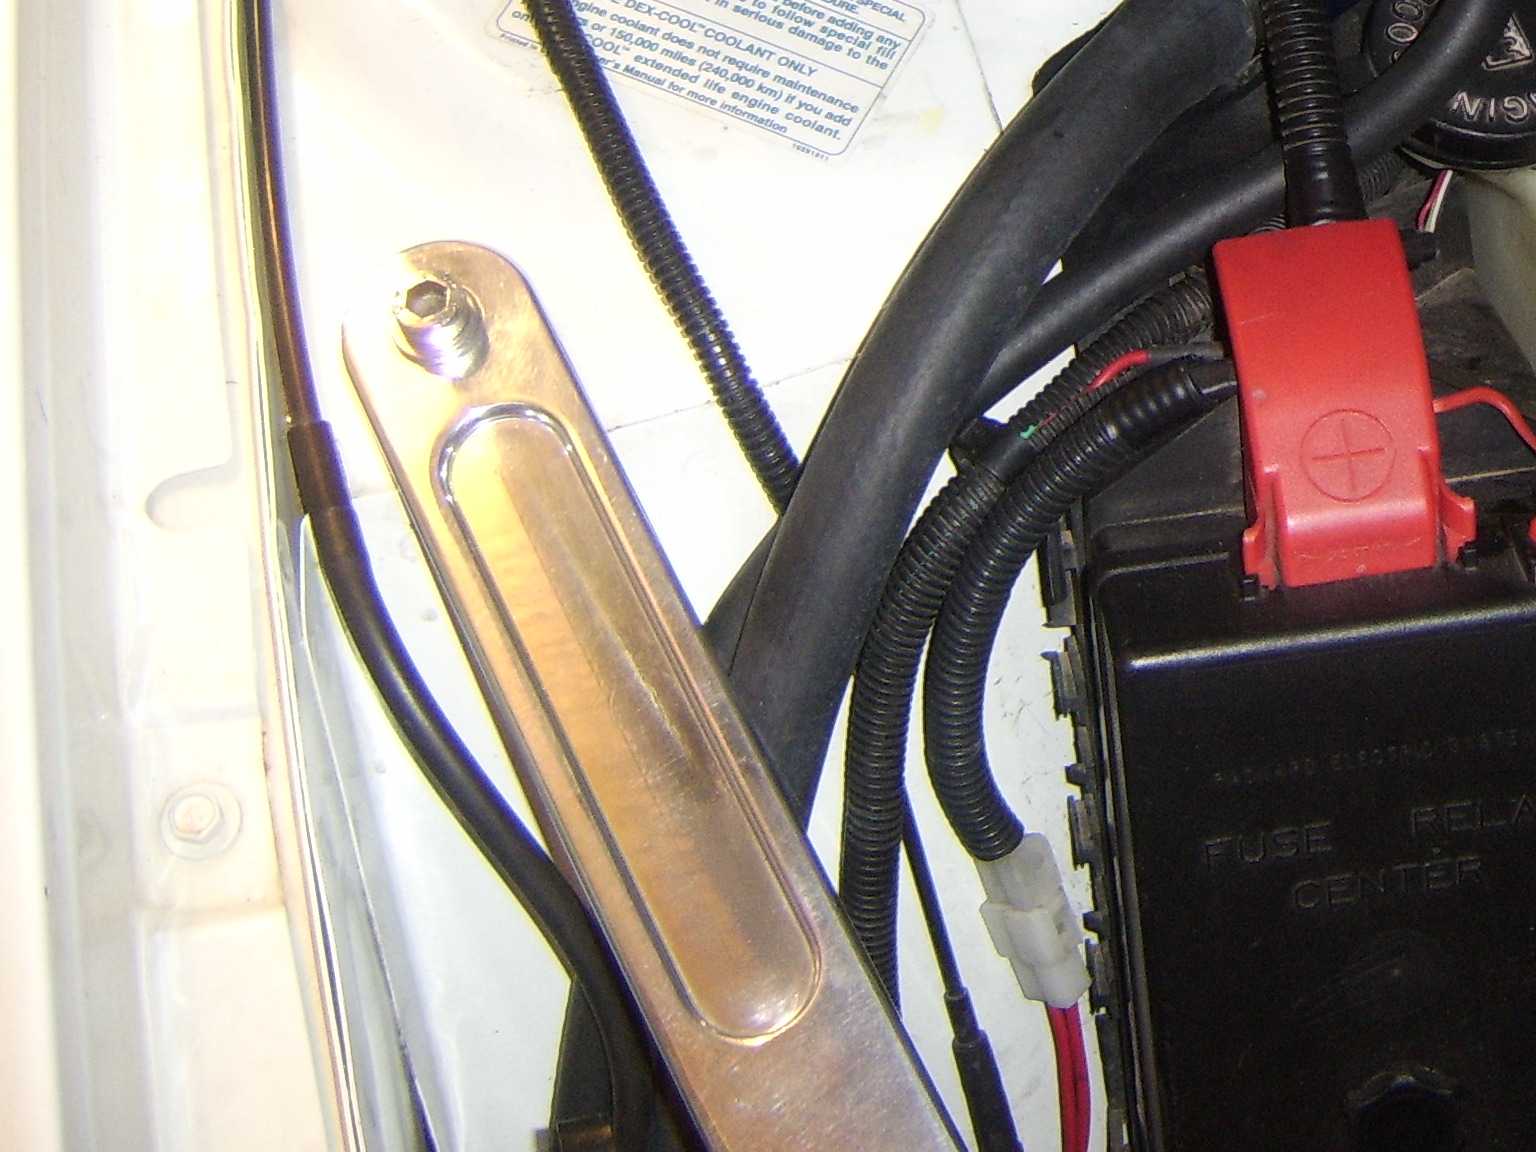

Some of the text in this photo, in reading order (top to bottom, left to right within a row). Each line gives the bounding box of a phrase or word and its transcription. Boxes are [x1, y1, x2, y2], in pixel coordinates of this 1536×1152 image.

[703, 27, 777, 61] COOLANT
[777, 55, 818, 78] ONLY
[731, 4, 785, 30] serious
[787, 25, 843, 53] damage
[846, 47, 862, 60] to
[865, 54, 889, 70] the
[770, 4, 816, 28] follow
[818, 25, 872, 51] special
[875, 45, 897, 60] fill
[826, 15, 875, 41] adding
[875, 34, 902, 51] any
[590, 22, 853, 127] or 150,000 miles (240,000 km) if you add
[609, 13, 661, 37] coolant
[661, 31, 696, 50] does
[696, 45, 722, 60] not
[721, 54, 771, 79] require
[771, 74, 860, 114] maintenance
[622, 64, 666, 86] Manual
[667, 81, 686, 94] for
[686, 89, 718, 106] more
[633, 54, 700, 84] extended
[702, 78, 727, 95] life
[730, 91, 780, 115] engine
[783, 112, 841, 140] coolant.
[1204, 819, 1334, 872] FUSE
[1293, 854, 1490, 909] CENTER
